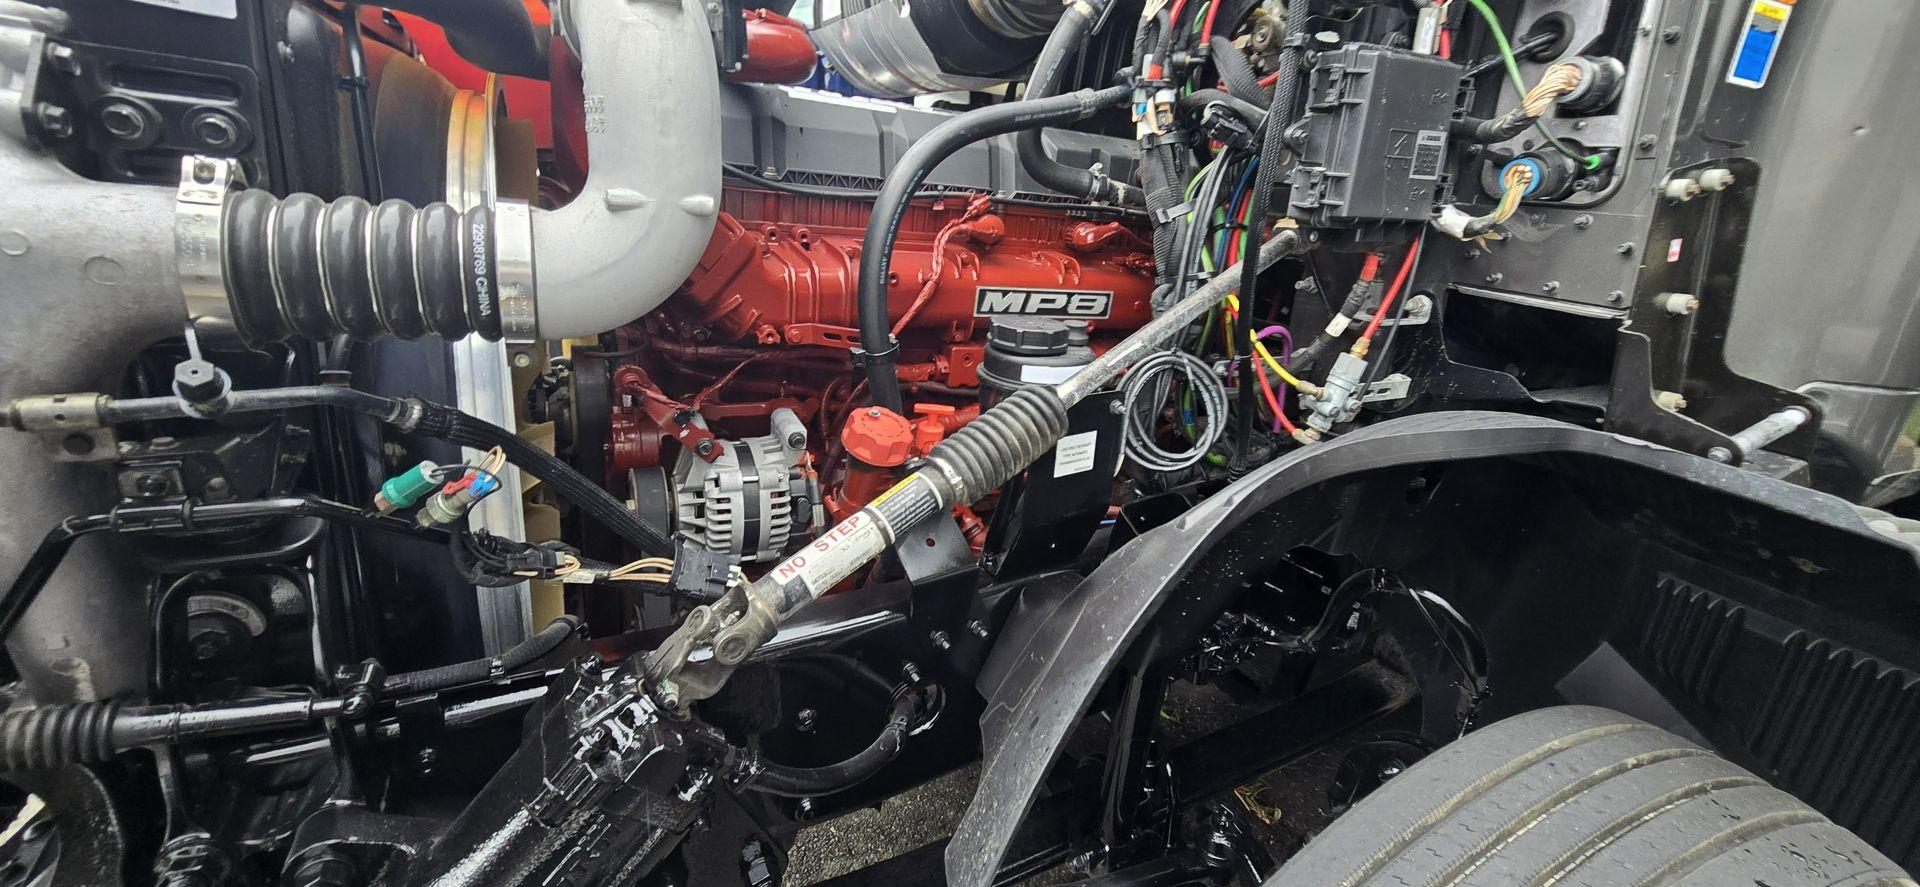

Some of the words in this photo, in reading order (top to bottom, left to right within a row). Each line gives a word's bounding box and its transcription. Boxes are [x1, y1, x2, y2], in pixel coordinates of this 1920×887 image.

[473, 223, 487, 275] 22908769
[475, 276, 492, 316] CHINA
[980, 290, 1109, 315] MP8
[778, 556, 807, 579] NO
[814, 515, 861, 552] STEP
